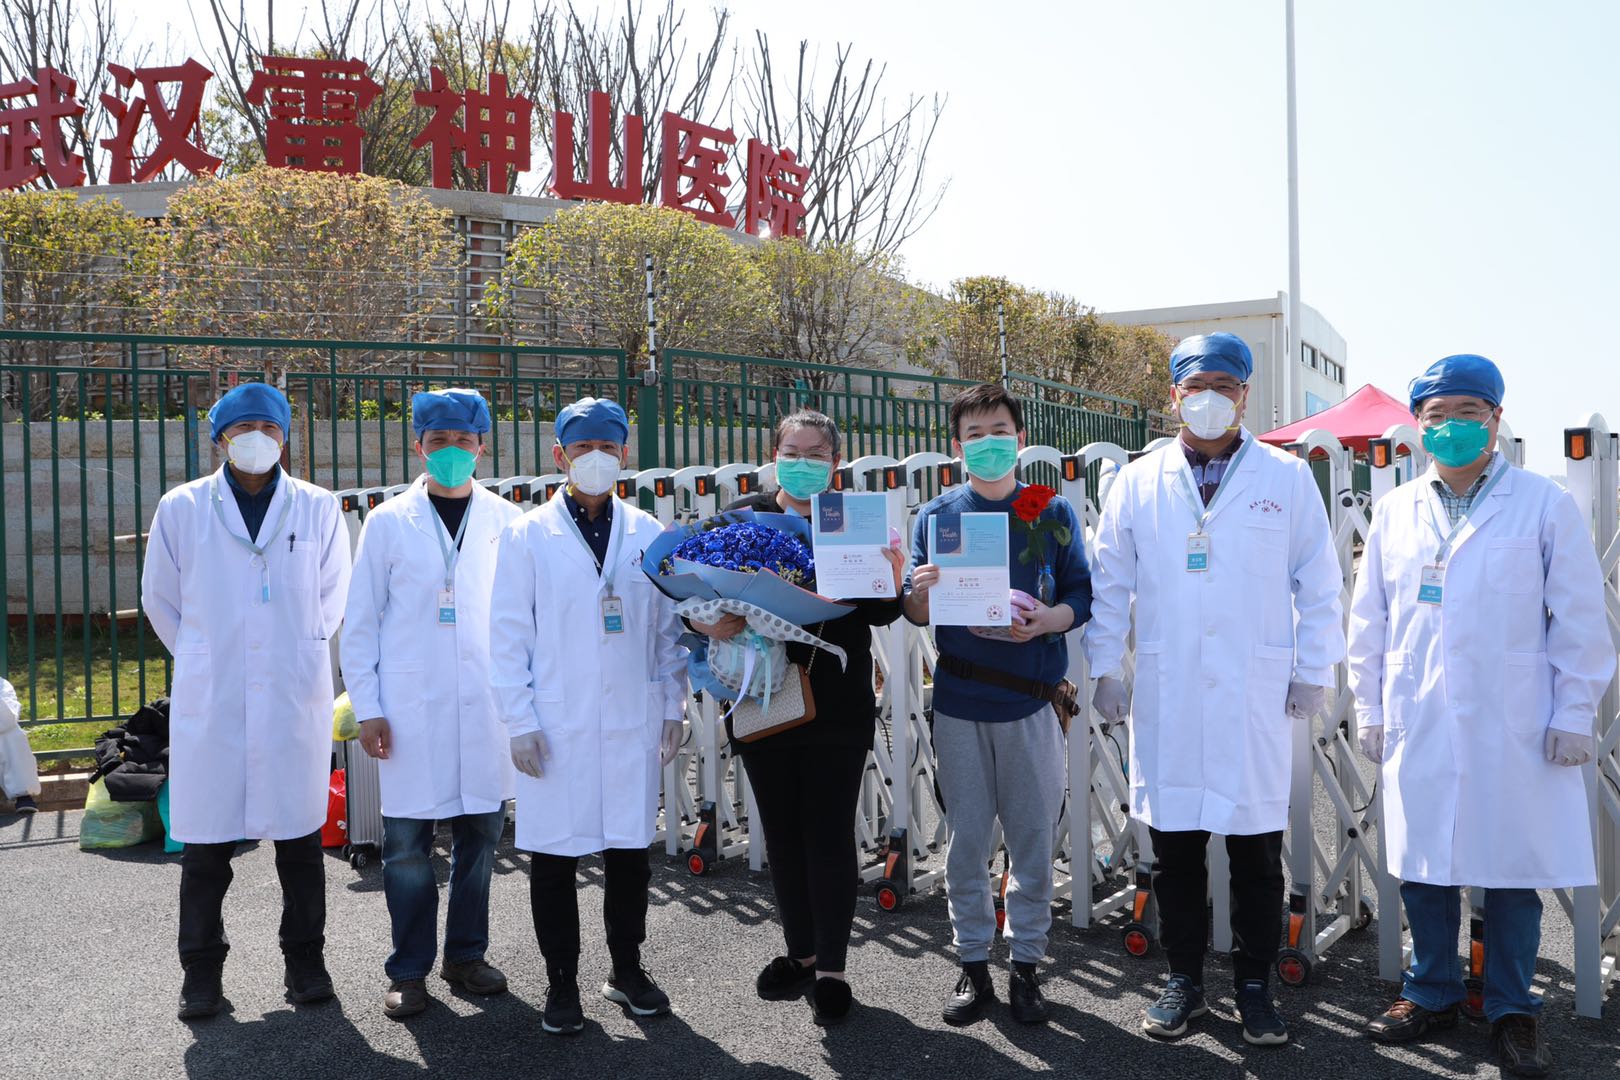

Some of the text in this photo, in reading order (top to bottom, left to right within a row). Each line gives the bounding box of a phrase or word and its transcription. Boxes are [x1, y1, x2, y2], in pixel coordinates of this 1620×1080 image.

[0, 56, 812, 239] 武汉雷神山医院
